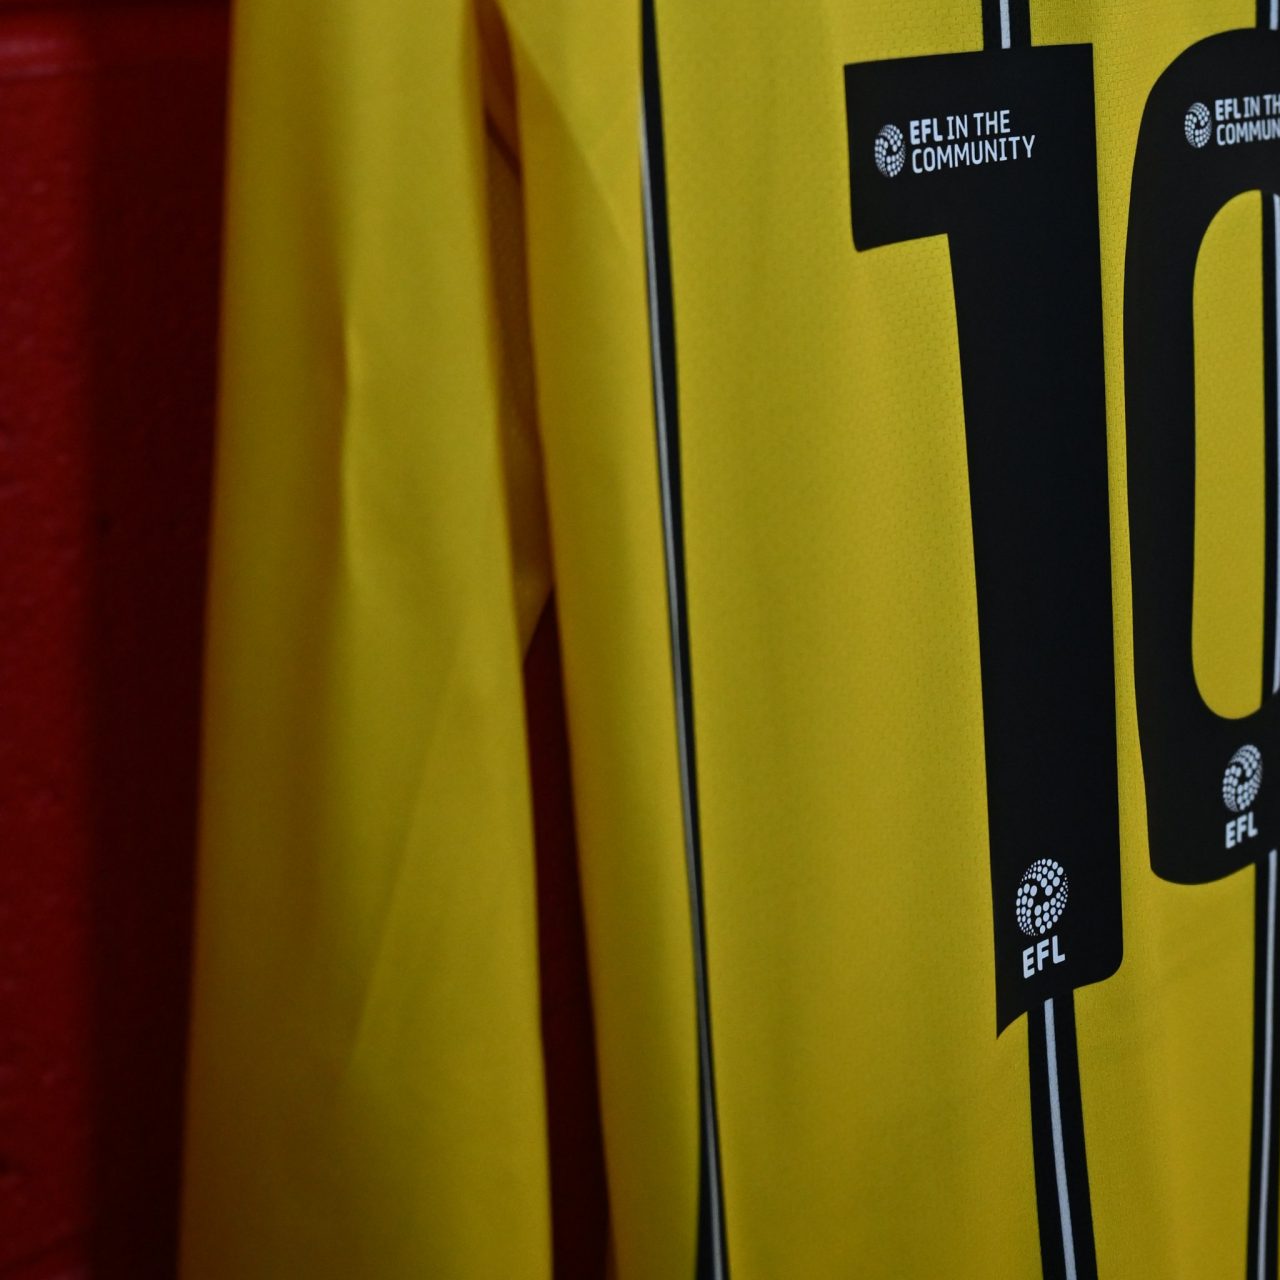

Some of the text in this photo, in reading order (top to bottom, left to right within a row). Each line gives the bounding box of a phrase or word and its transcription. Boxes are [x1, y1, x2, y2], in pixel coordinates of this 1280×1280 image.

[909, 108, 1011, 146] EFL IN THE
[1214, 97, 1242, 122] EFL
[1242, 95, 1261, 119] IN
[911, 134, 1036, 174] COMMUNITY
[1224, 811, 1259, 849] EFL
[1022, 934, 1066, 979] EFL
